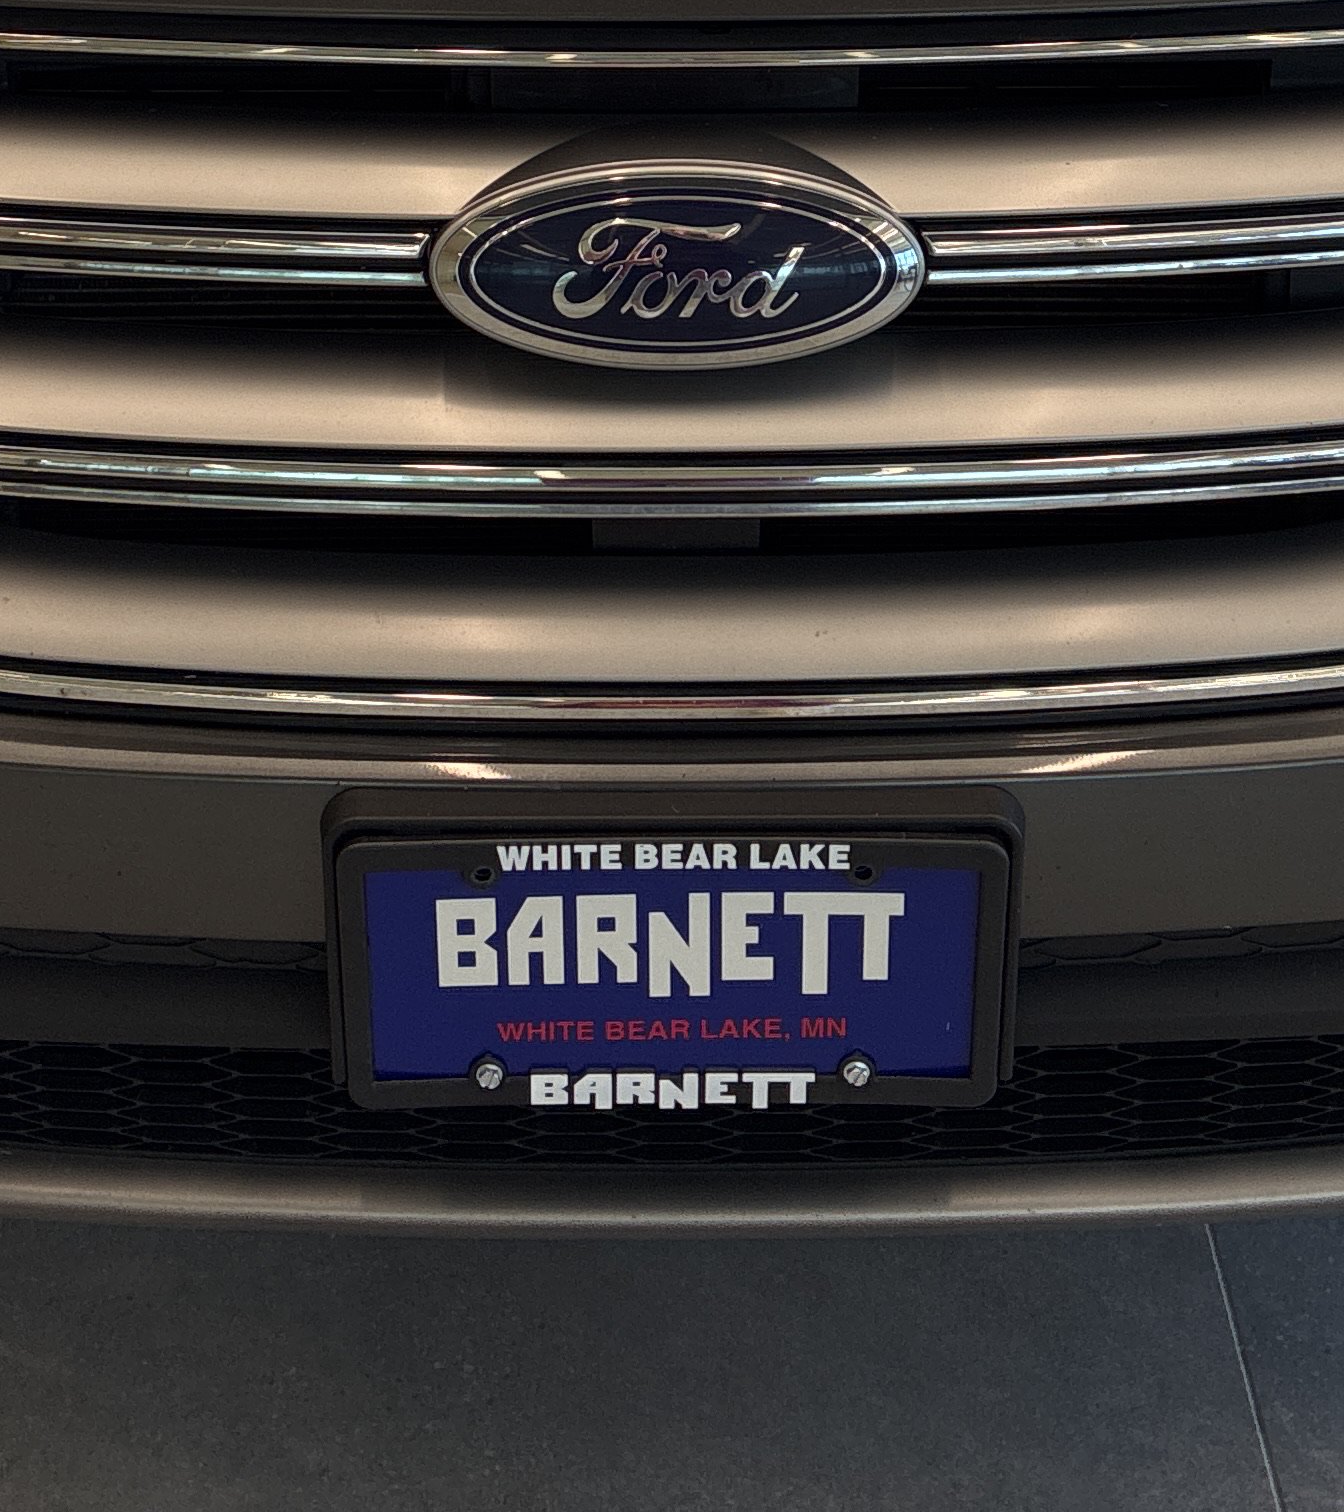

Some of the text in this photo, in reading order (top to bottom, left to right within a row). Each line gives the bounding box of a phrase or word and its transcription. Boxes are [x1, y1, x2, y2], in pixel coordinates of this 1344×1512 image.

[552, 217, 806, 319] Ford
[496, 843, 851, 871] WHITE BEAR LAKE
[435, 892, 905, 997] BARNETT
[497, 1017, 847, 1043] WHITE BEAR LAKE, MN
[530, 1072, 816, 1110] BARNETT
